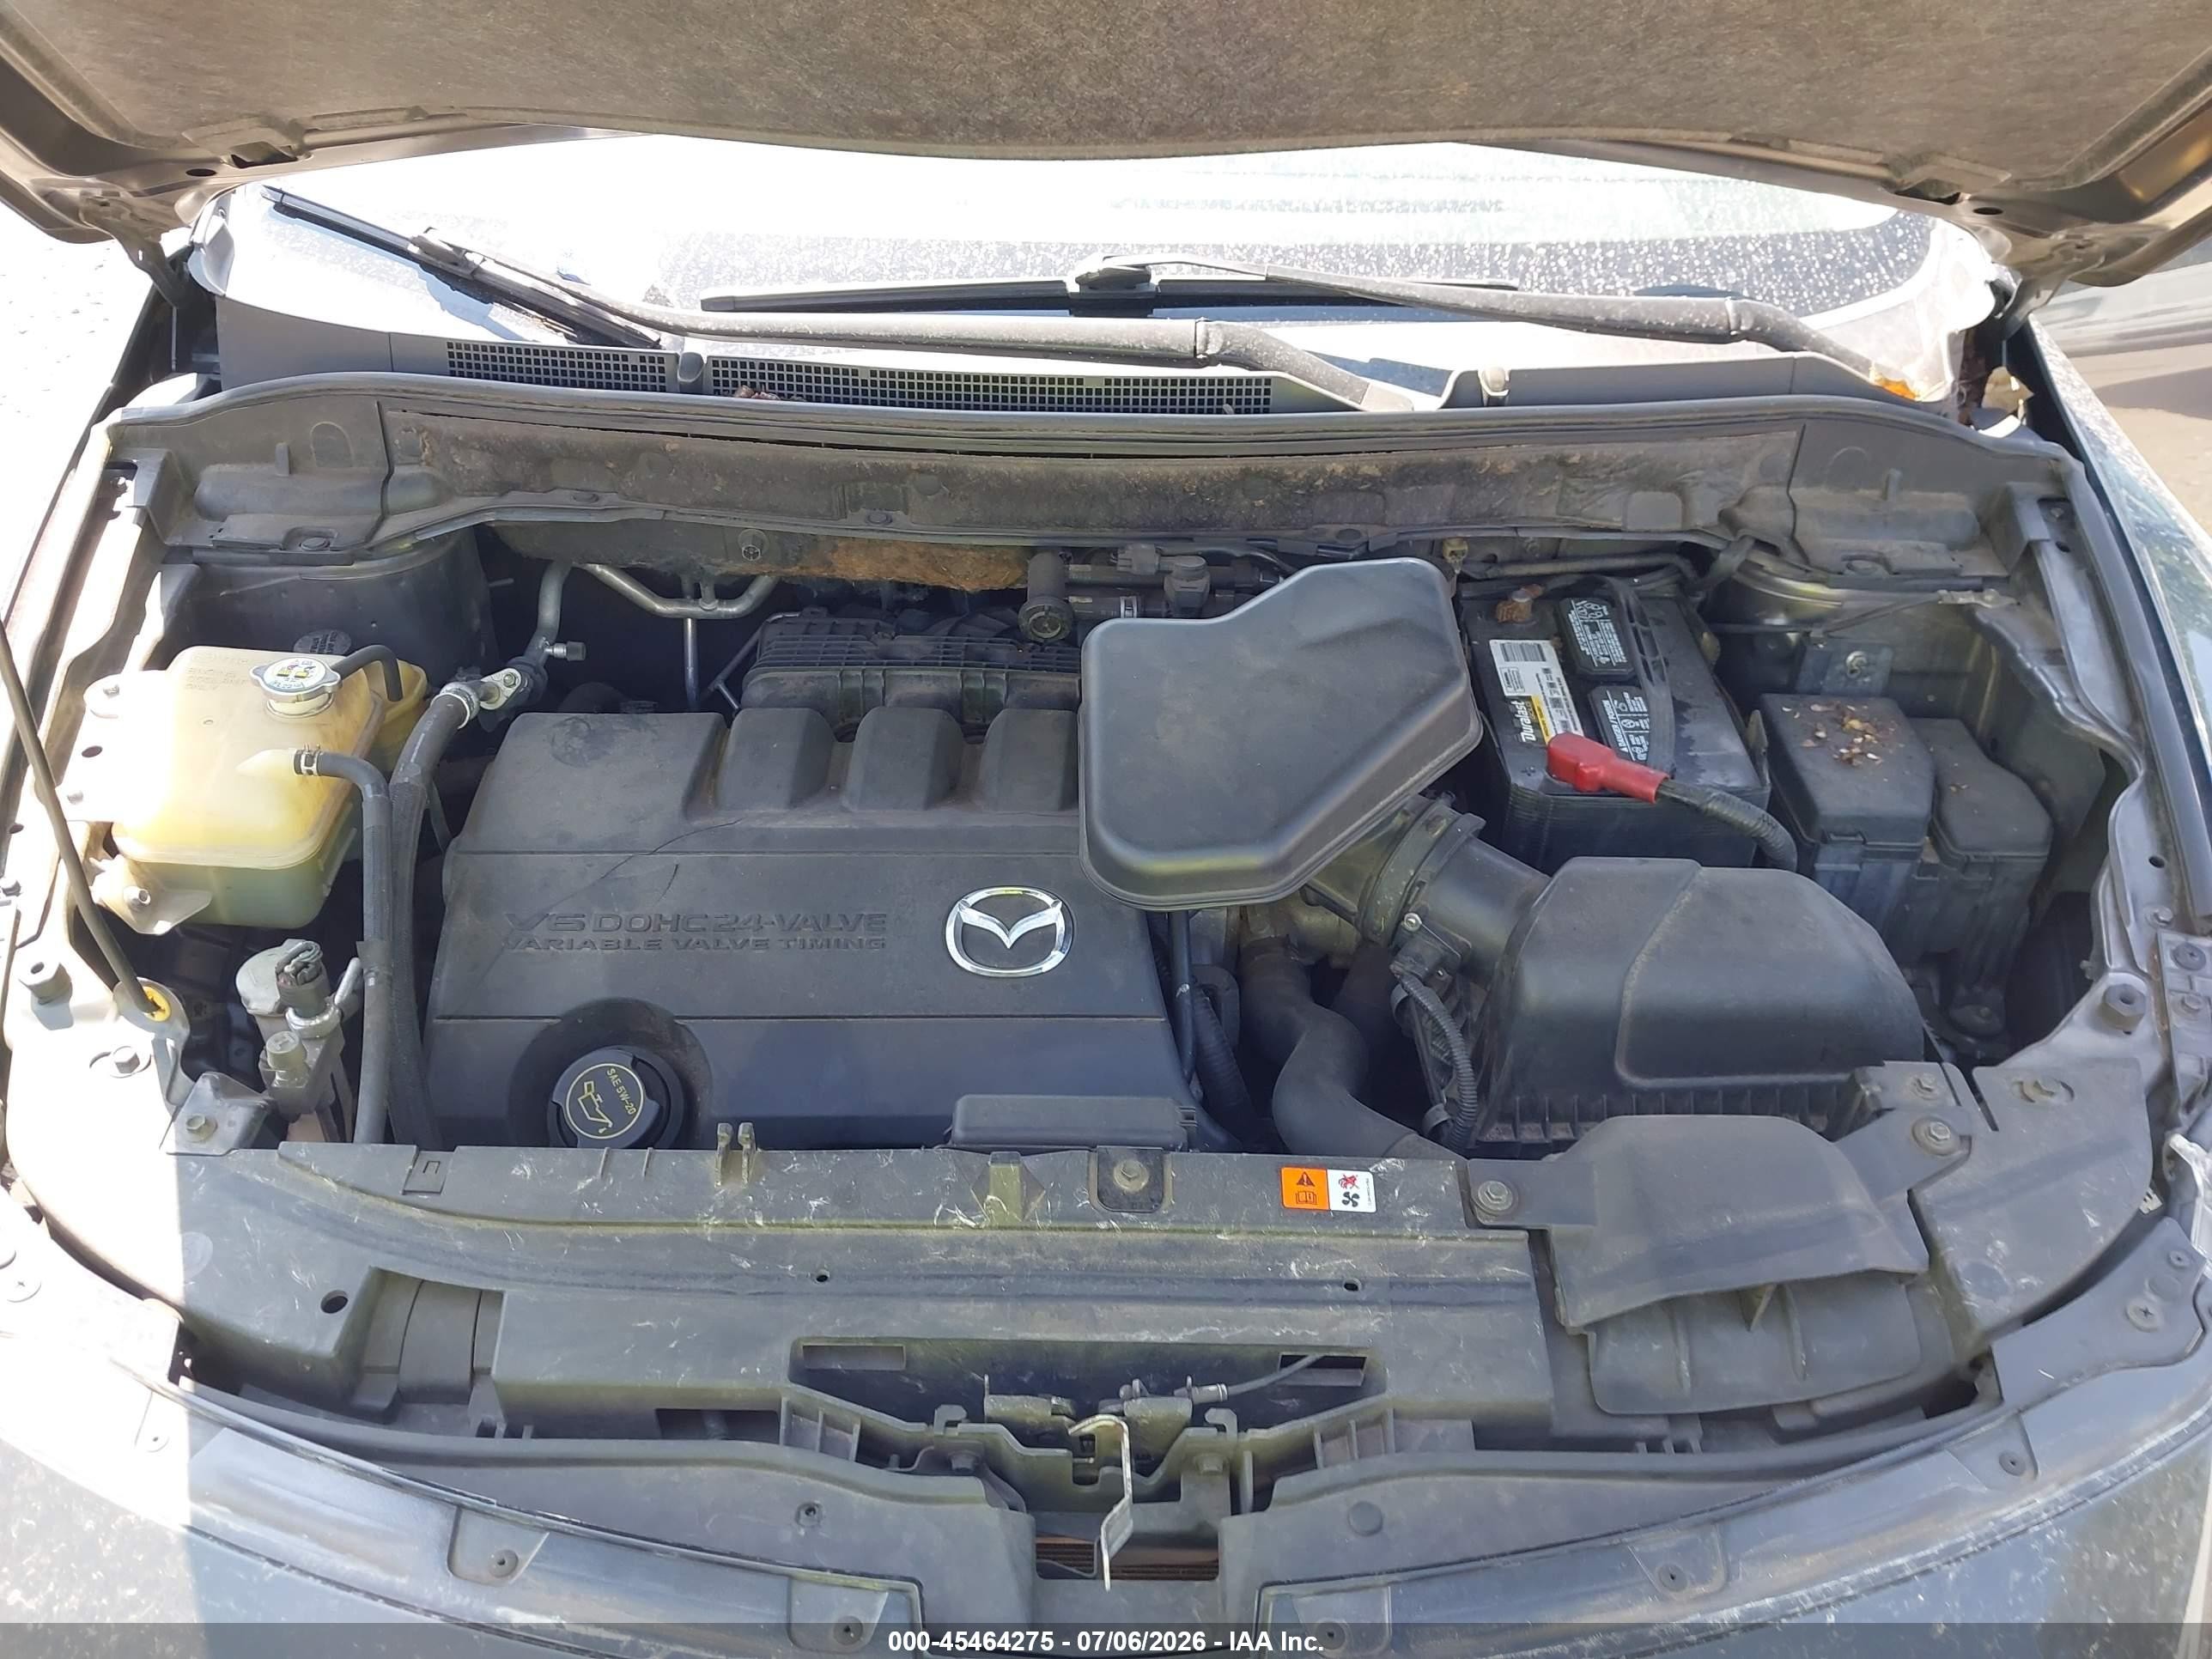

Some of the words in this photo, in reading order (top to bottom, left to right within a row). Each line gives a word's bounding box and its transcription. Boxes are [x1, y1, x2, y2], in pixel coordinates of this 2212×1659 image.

[1511, 701, 1536, 743] Duralast
[508, 938, 662, 951] VARIABLE
[672, 938, 770, 951] VALVE
[778, 938, 886, 951] TIMING
[606, 1067, 623, 1087] SAE
[616, 1085, 637, 1115] 5W-20
